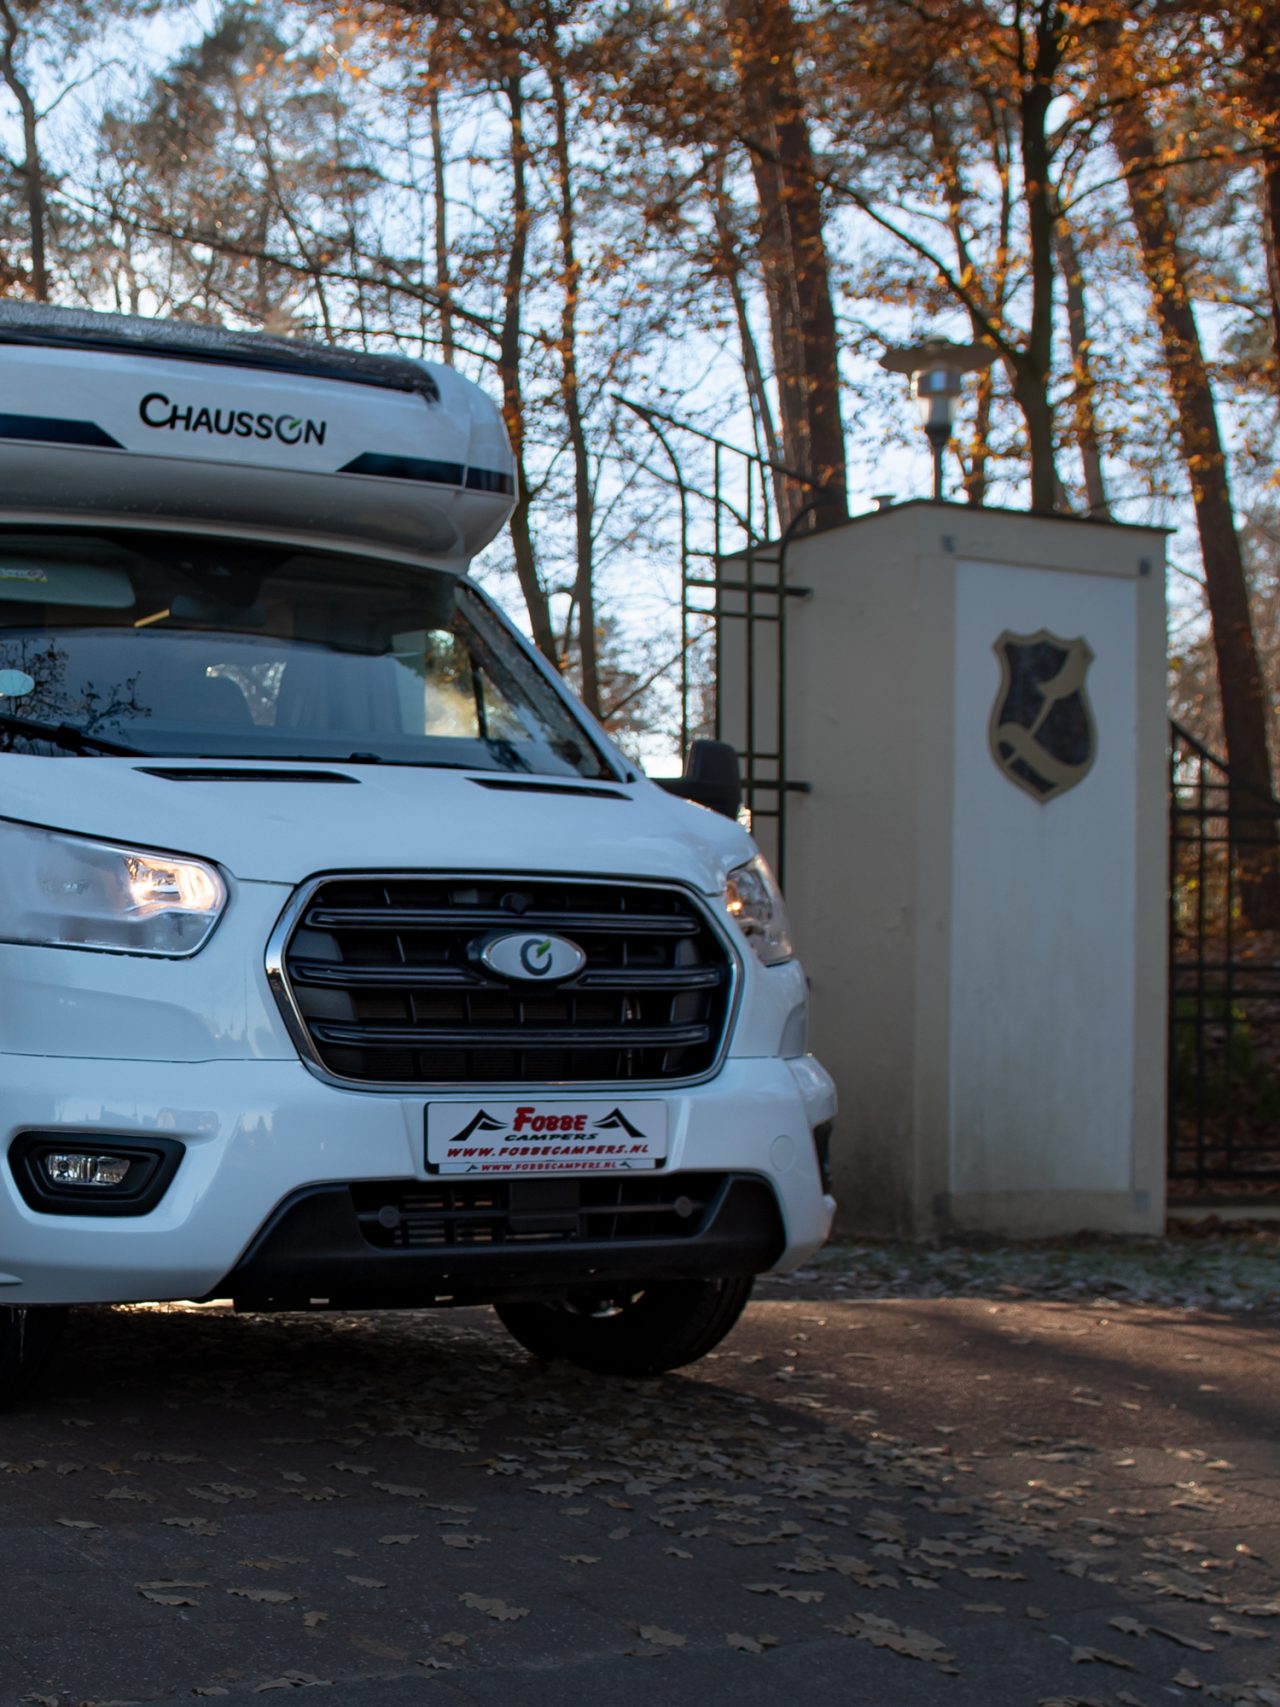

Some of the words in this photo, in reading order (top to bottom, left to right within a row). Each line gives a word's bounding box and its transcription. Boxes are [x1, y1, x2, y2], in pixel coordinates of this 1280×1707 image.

[138, 392, 326, 445] CHAUSSON
[513, 1107, 588, 1132] FOBBE
[504, 1133, 599, 1142] CAMPERS
[447, 1144, 649, 1158] WWW.FOBBECAMPERS.NL
[481, 1161, 616, 1172] WWW.FOBBECAMPERS.NL
